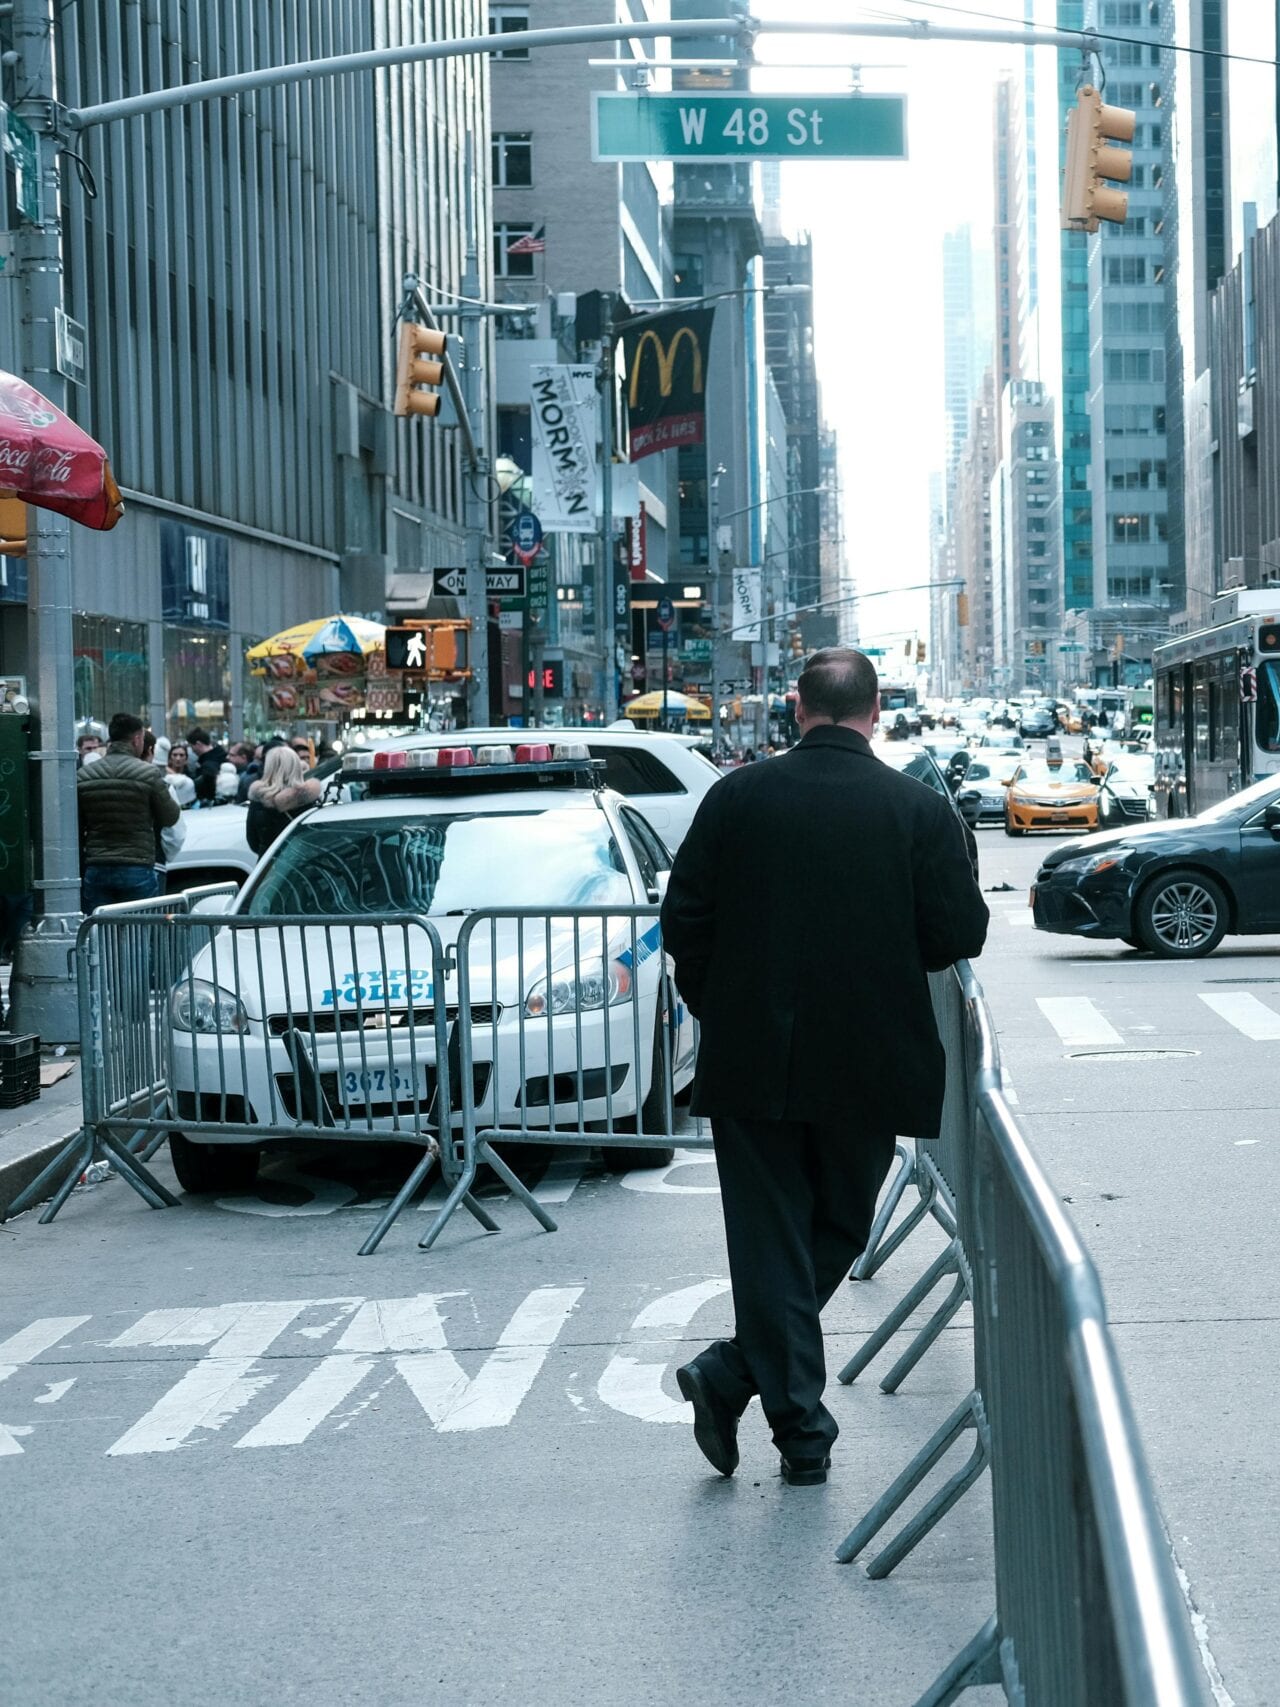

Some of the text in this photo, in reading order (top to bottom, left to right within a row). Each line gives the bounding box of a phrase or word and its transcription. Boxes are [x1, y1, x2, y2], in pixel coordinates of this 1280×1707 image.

[679, 108, 824, 146] W 48 St
[572, 371, 593, 379] NYC
[447, 576, 512, 588] ON WAY
[342, 969, 429, 984] NYPD
